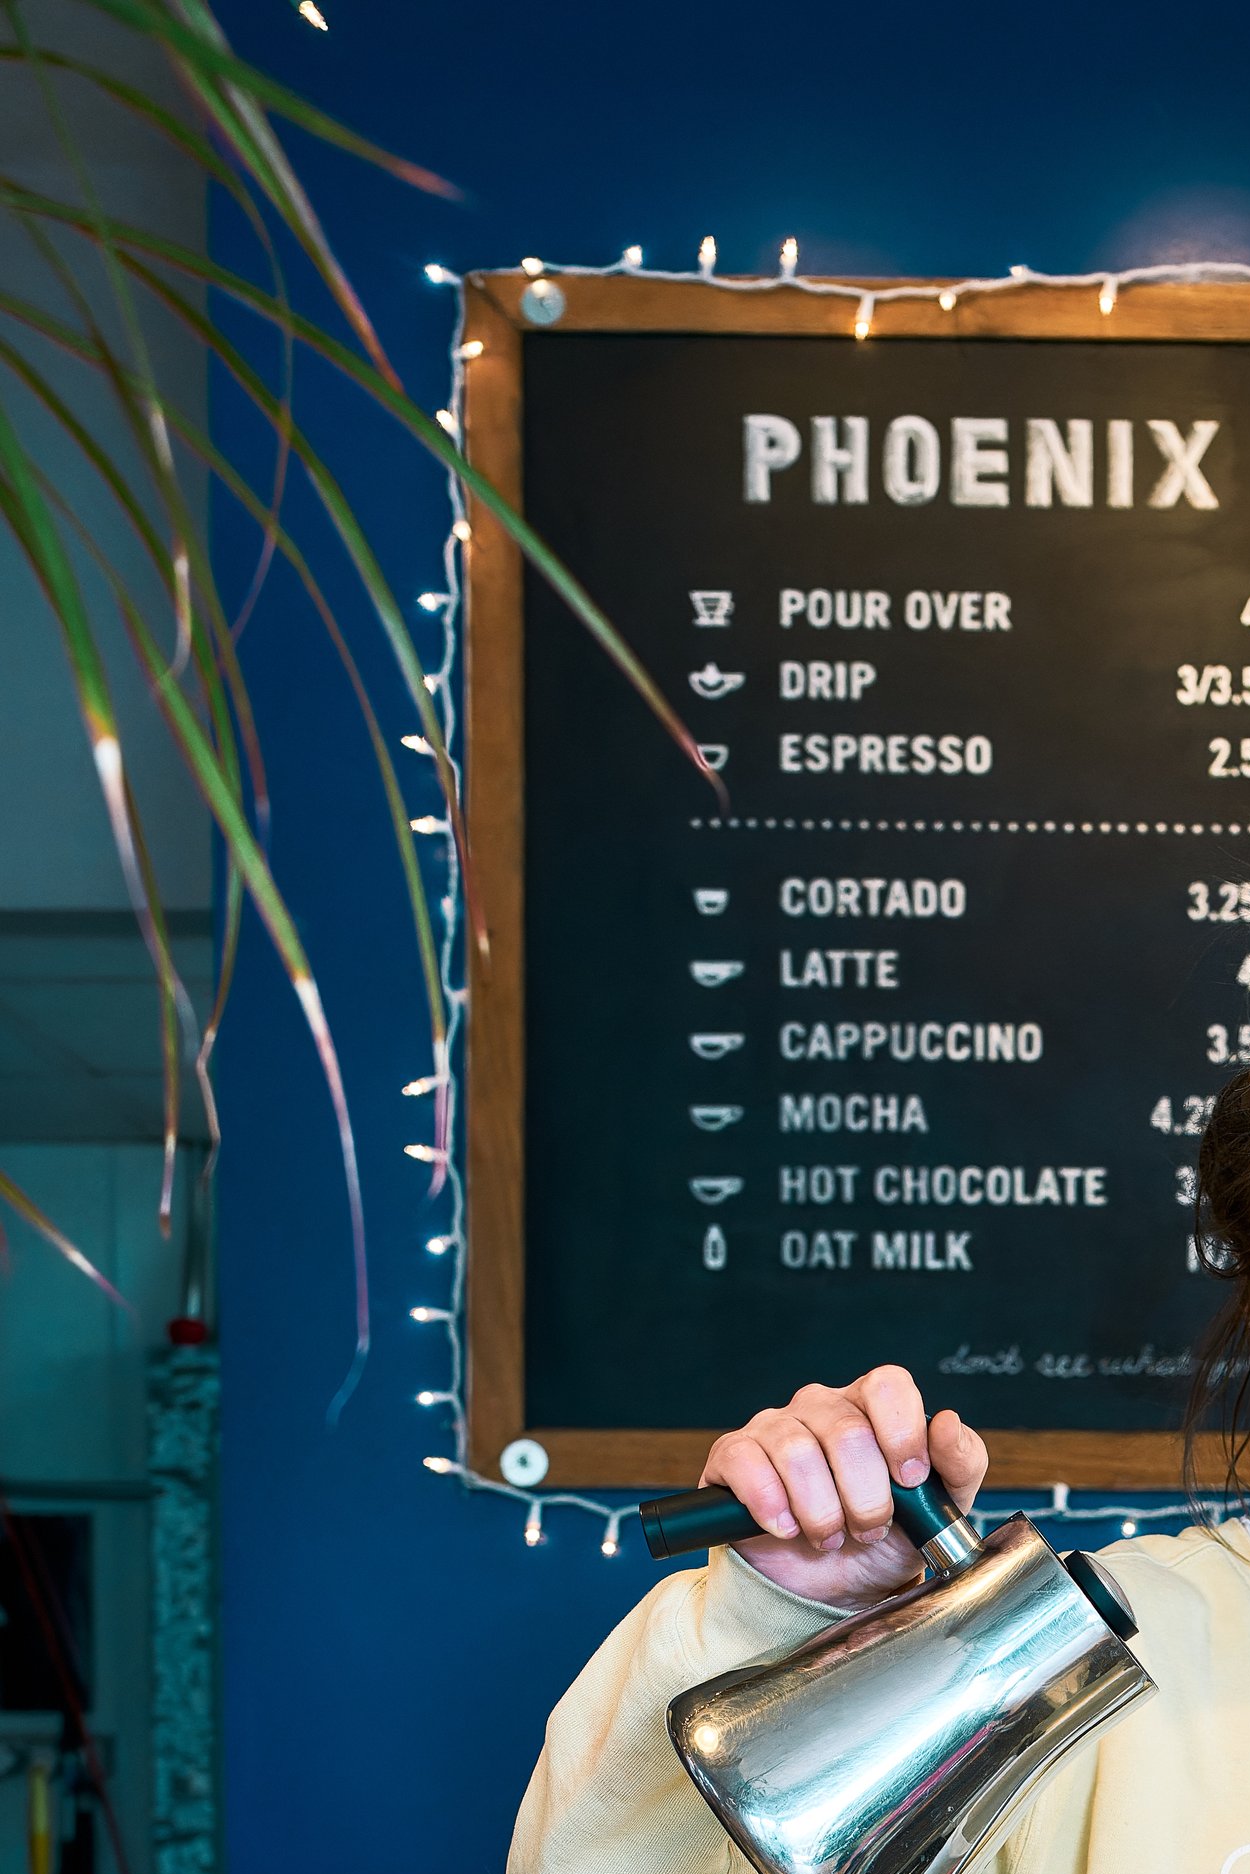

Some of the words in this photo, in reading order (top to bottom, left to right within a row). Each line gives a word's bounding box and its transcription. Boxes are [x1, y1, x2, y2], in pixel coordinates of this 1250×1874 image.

[743, 413, 1220, 510] PHOENIX
[780, 588, 892, 630] POUR
[904, 589, 1012, 632] OVER
[780, 661, 877, 700] DRIP
[779, 734, 993, 775] ESPRESSO
[780, 878, 967, 919] CORTADO
[780, 950, 900, 988] LATTE
[780, 1022, 1043, 1062] CAPPUCCINO
[780, 1094, 929, 1133] MOCHA
[780, 1166, 858, 1204] HOT
[874, 1167, 1108, 1207] CHOCOLATE
[781, 1231, 856, 1269] OAT
[872, 1231, 973, 1271] MILK
